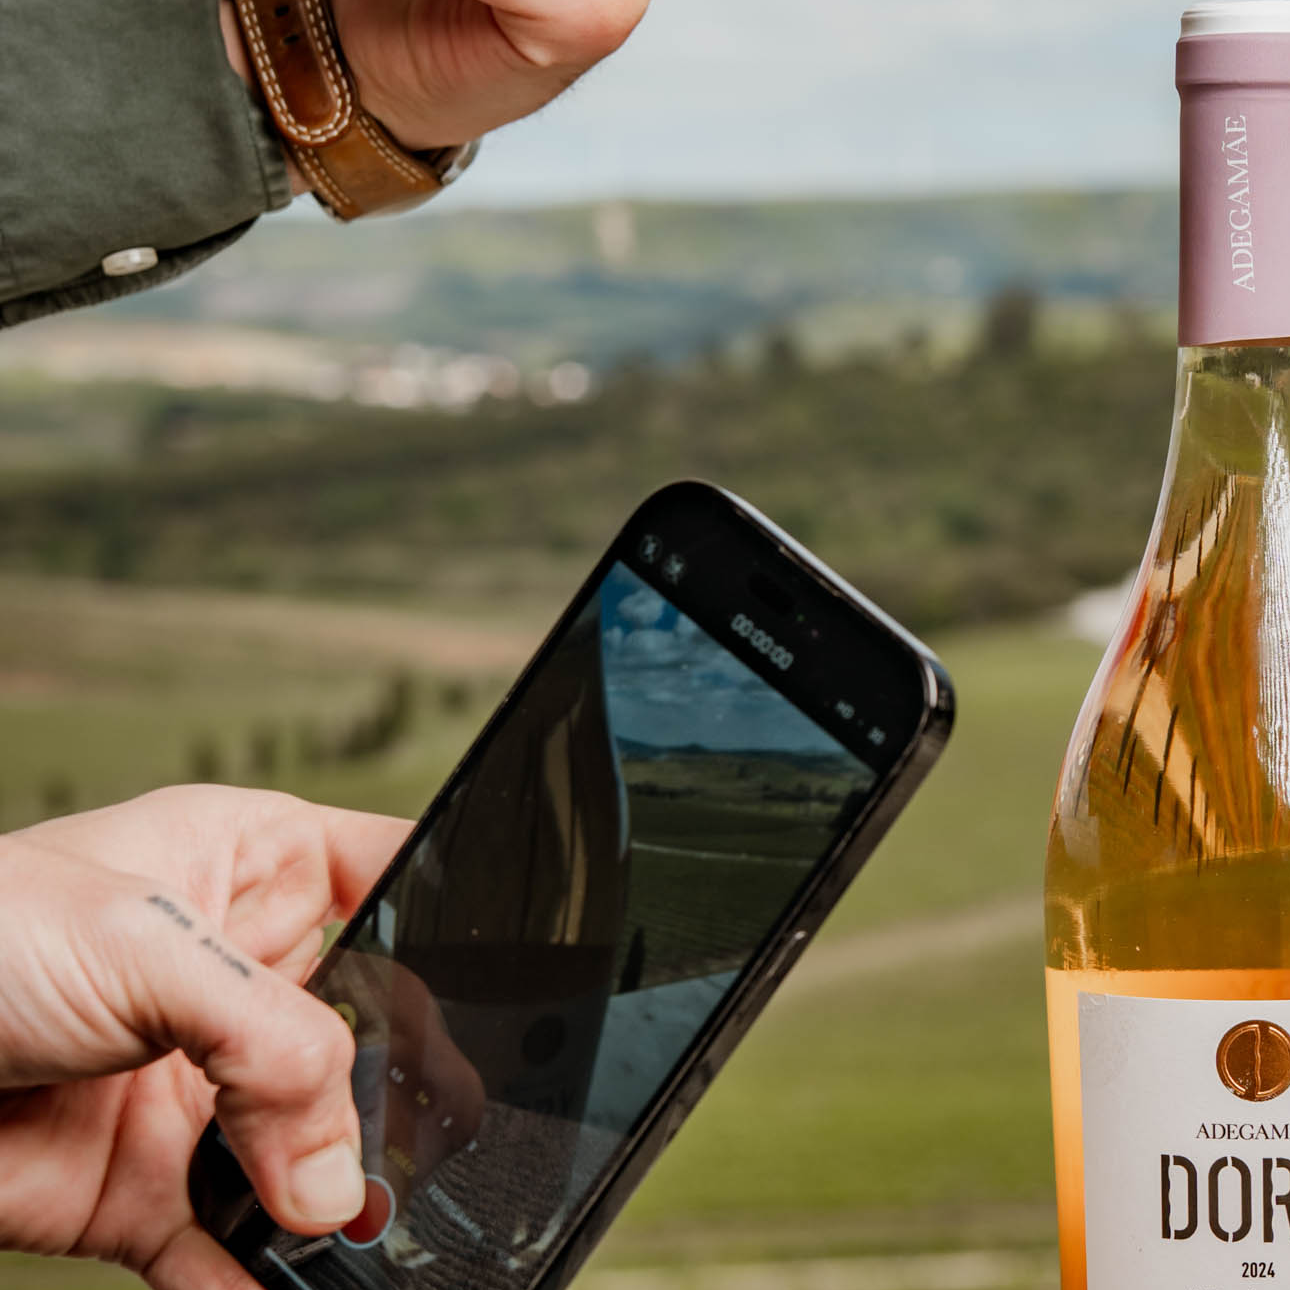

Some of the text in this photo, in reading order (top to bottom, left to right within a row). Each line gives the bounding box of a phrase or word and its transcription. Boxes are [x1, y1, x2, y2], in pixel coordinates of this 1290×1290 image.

[1221, 115, 1256, 293] ADEGAMÃE
[730, 613, 794, 671] 00:00:00
[1241, 1261, 1276, 1279] 2024
